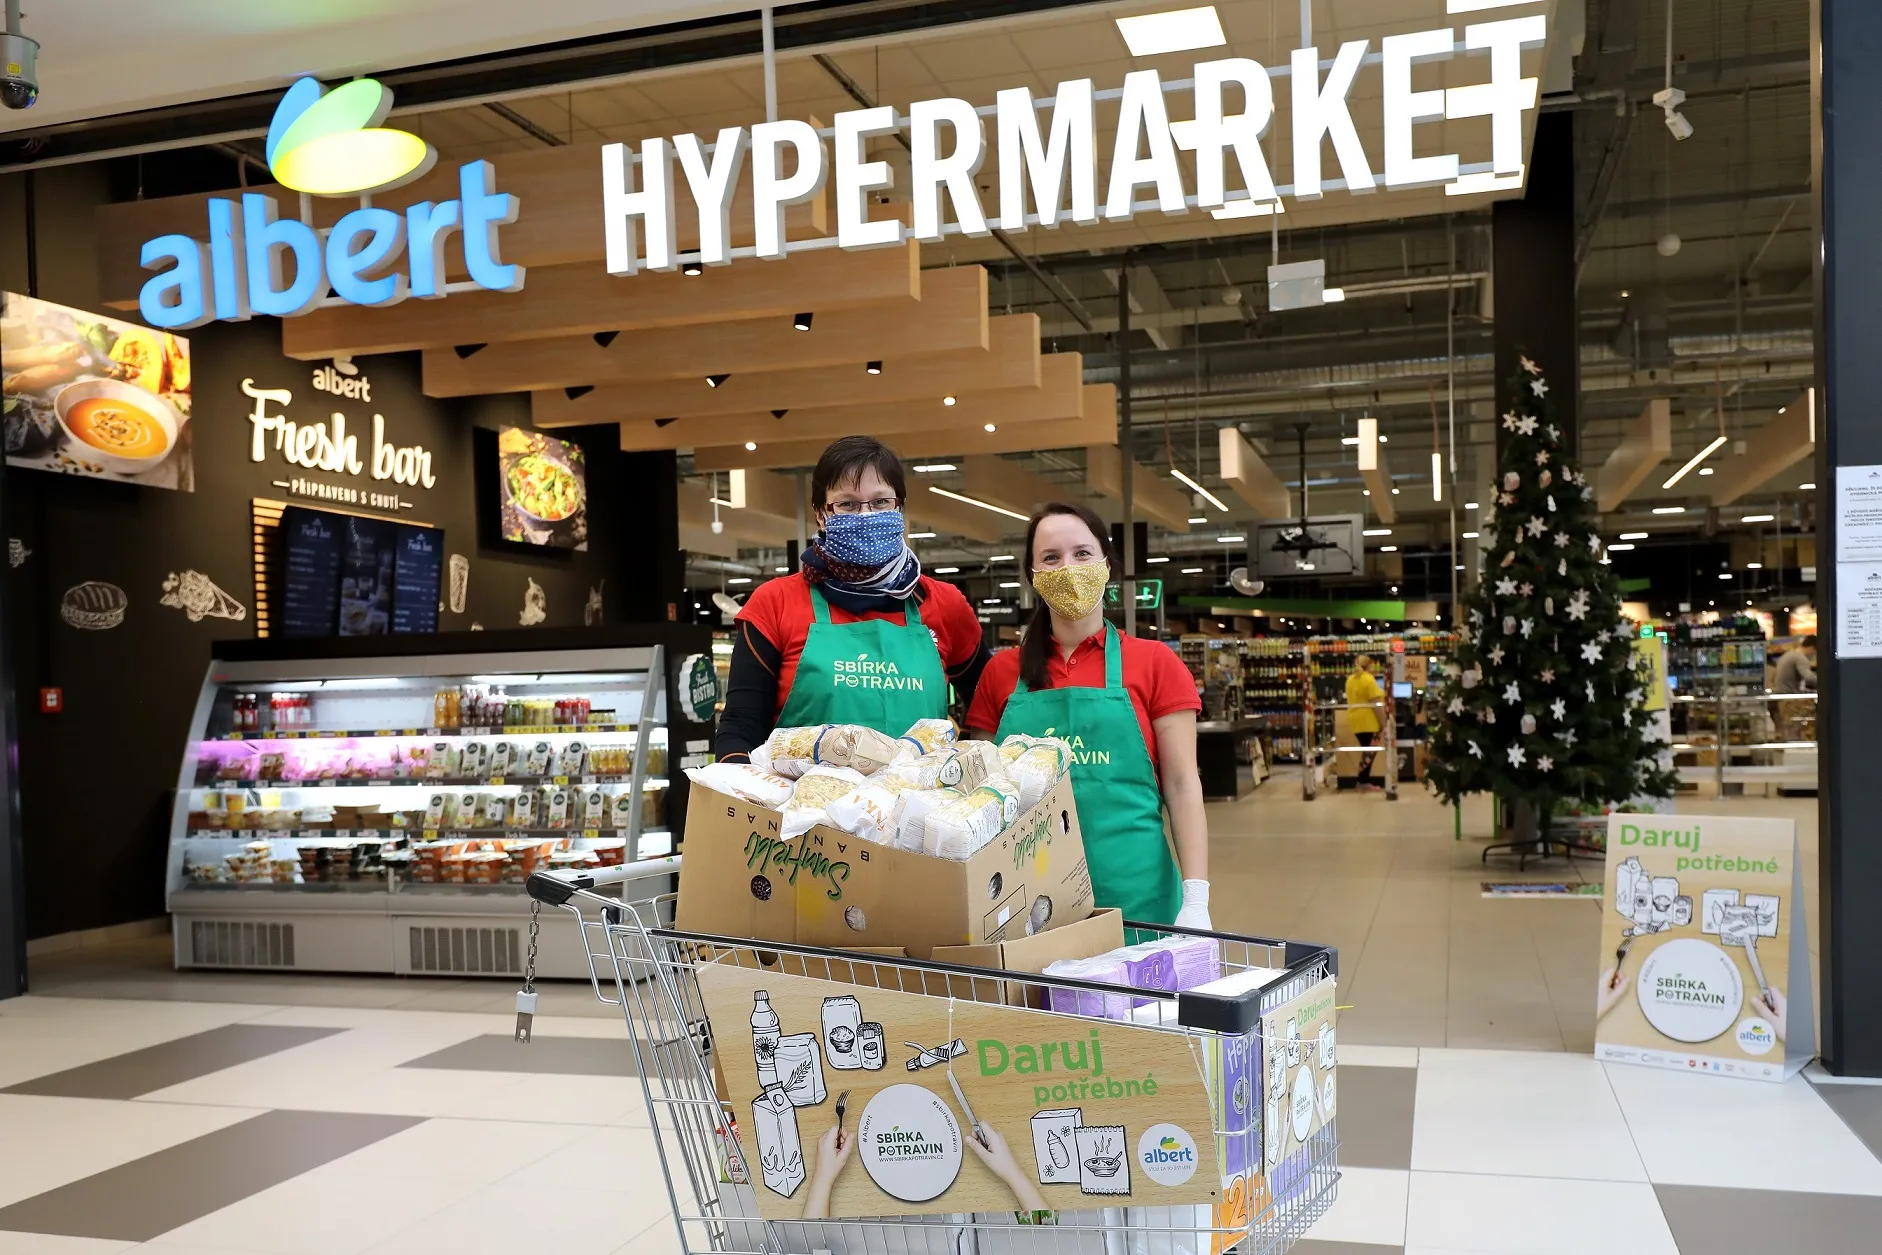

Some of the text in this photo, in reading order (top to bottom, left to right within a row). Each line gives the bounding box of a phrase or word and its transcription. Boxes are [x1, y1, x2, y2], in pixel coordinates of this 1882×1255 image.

[600, 15, 1547, 276] HYPERMARKET
[139, 159, 525, 329] albert
[312, 366, 371, 402] albert
[241, 377, 436, 489] Fresh bar
[291, 477, 399, 510] PŘIPRAVENO S CHUTÍ
[692, 682, 715, 704] BISTRO
[833, 674, 924, 692] POTRAVIN
[1070, 751, 1110, 765] AVIN
[727, 806, 870, 862] BANNAS
[1620, 824, 1701, 853] Daruj
[1676, 854, 1778, 874] potřebné
[1656, 989, 1726, 1005] POTRAVIN
[1297, 1003, 1317, 1027] Daruj
[1739, 1030, 1772, 1044] albert
[976, 1029, 1104, 1077] Daruj
[1033, 1072, 1159, 1107] potřebné
[862, 1115, 873, 1143] #Albert
[877, 1143, 944, 1157] POTRAVIN
[1144, 1147, 1193, 1163] albert
